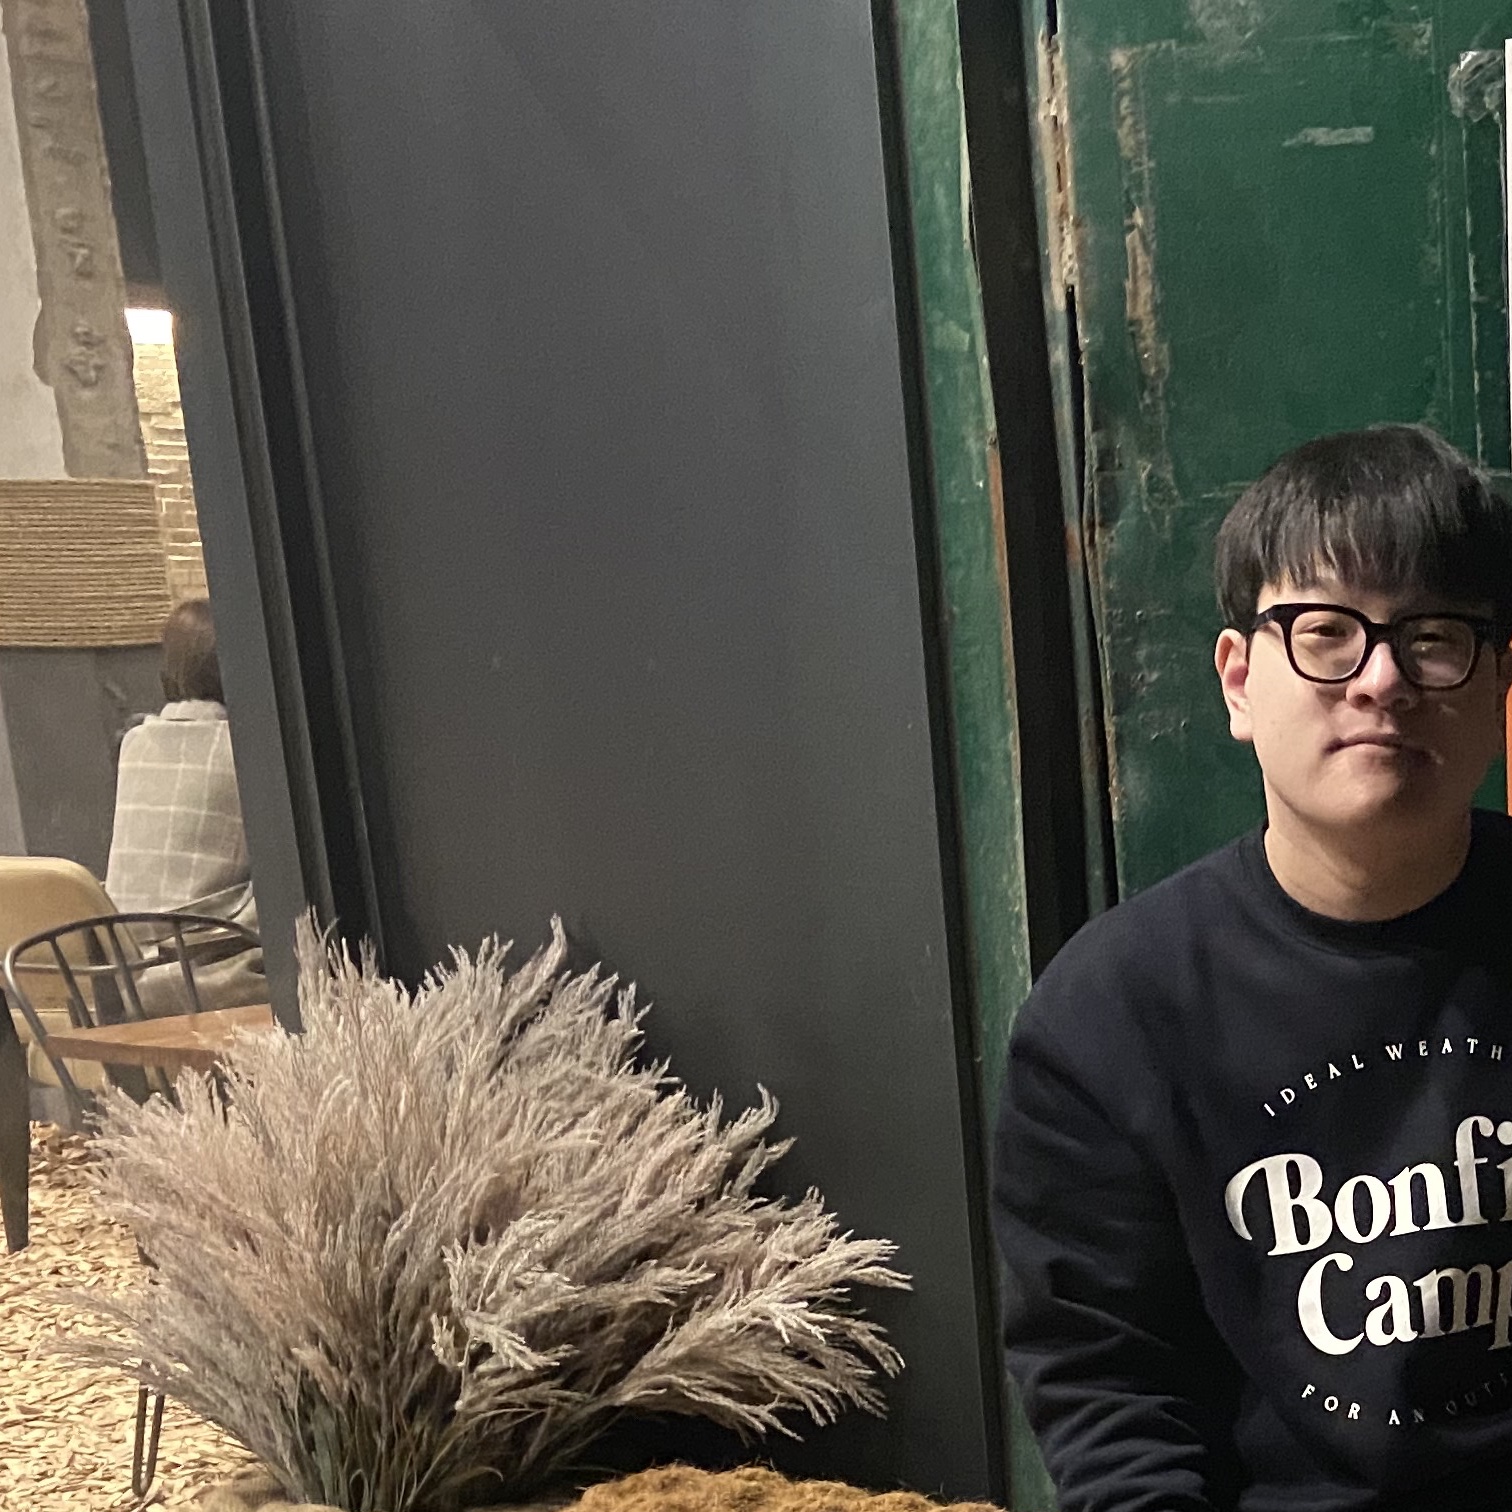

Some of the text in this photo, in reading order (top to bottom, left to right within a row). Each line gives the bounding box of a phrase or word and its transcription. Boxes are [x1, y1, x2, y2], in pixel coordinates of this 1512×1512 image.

[1263, 1054, 1364, 1117] IDEAL
[1302, 1383, 1361, 1420] FOR
[1388, 1408, 1426, 1427] AN
